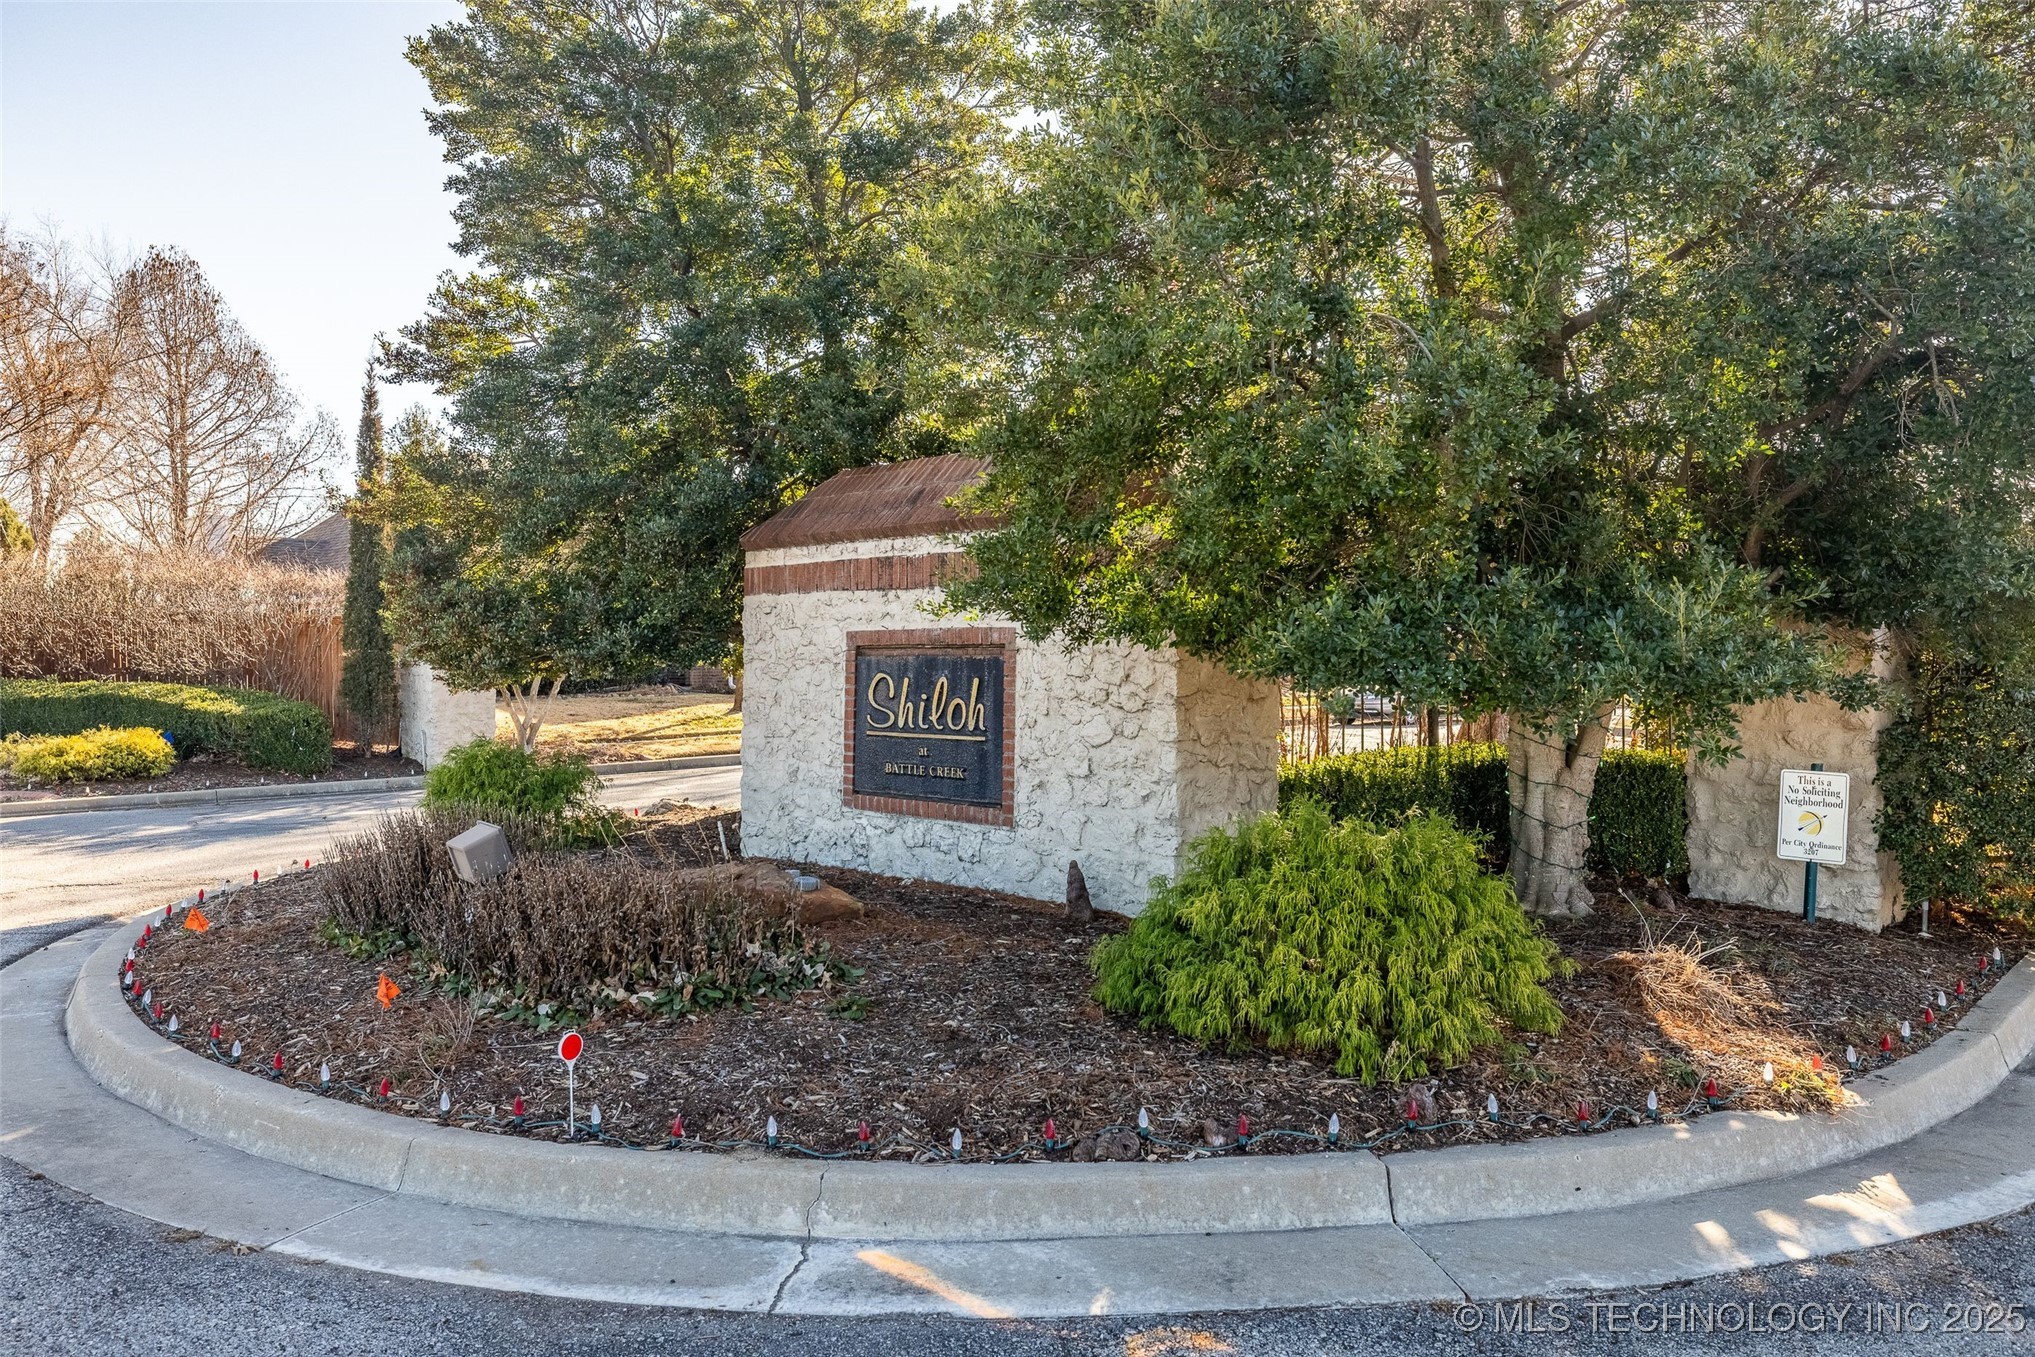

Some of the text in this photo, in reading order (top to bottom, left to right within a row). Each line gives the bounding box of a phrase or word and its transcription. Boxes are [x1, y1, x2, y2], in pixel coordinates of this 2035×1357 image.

[867, 672, 986, 731] Shiloh
[918, 747, 928, 756] at
[885, 763, 965, 779] BATTLE CREEK
[1798, 776, 1816, 785] This
[1818, 777, 1824, 786] is
[1788, 785, 1841, 799] No Soliciting
[1784, 796, 1843, 809] Neighborhood
[1782, 838, 1842, 851] Per City Ordinance
